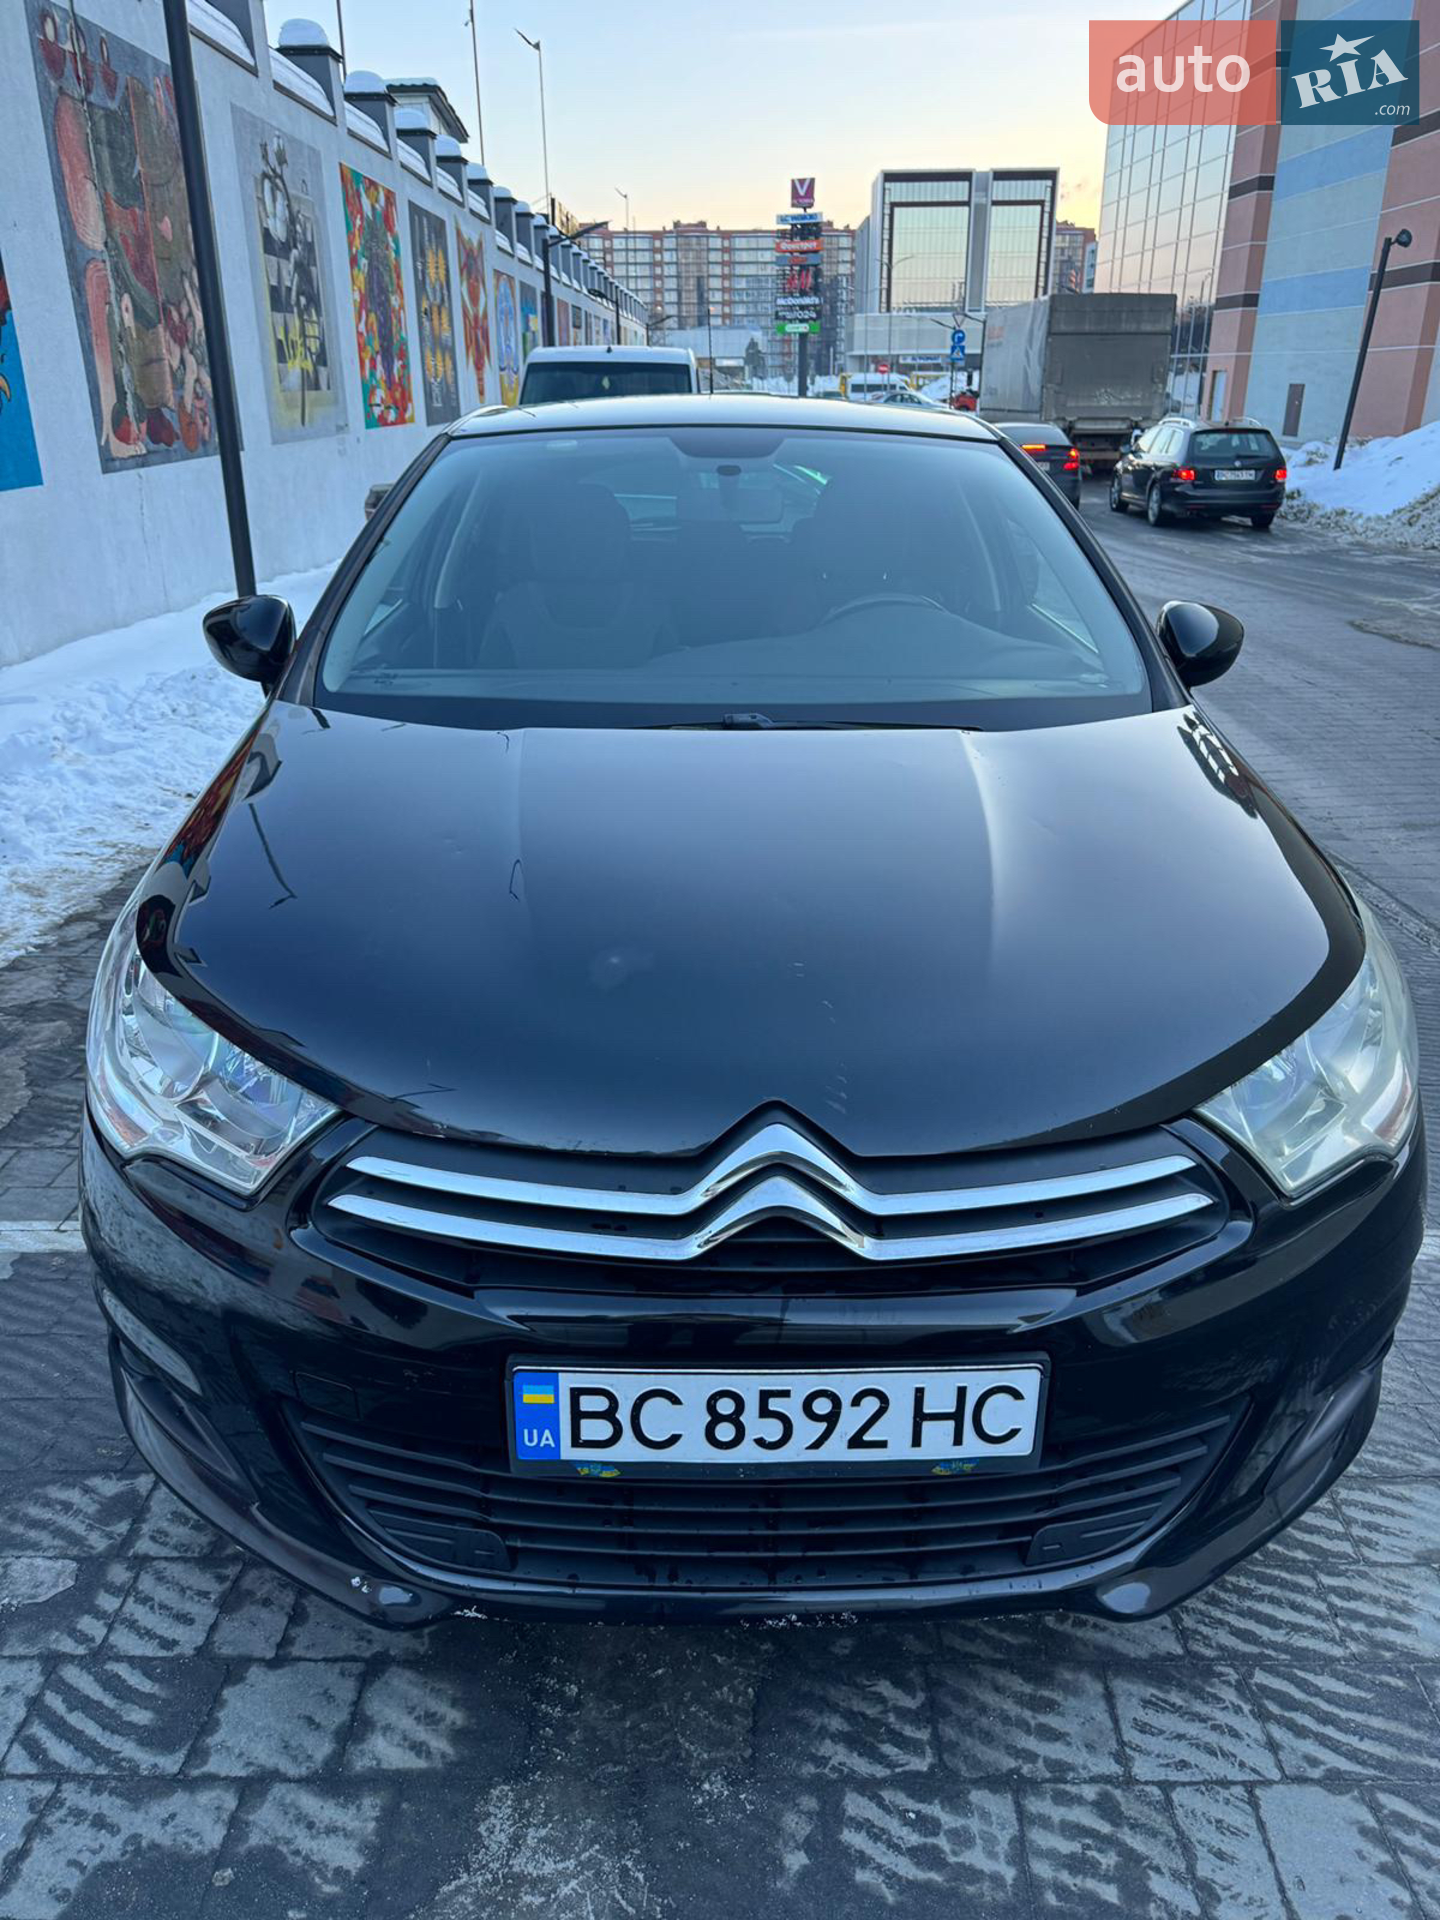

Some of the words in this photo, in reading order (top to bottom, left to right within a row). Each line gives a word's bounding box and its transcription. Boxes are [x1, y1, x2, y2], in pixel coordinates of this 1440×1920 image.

[794, 178, 811, 196] V
[569, 1386, 683, 1450] BC
[704, 1387, 889, 1451] 8592
[911, 1385, 1026, 1449] HC
[523, 1429, 556, 1449] UA
